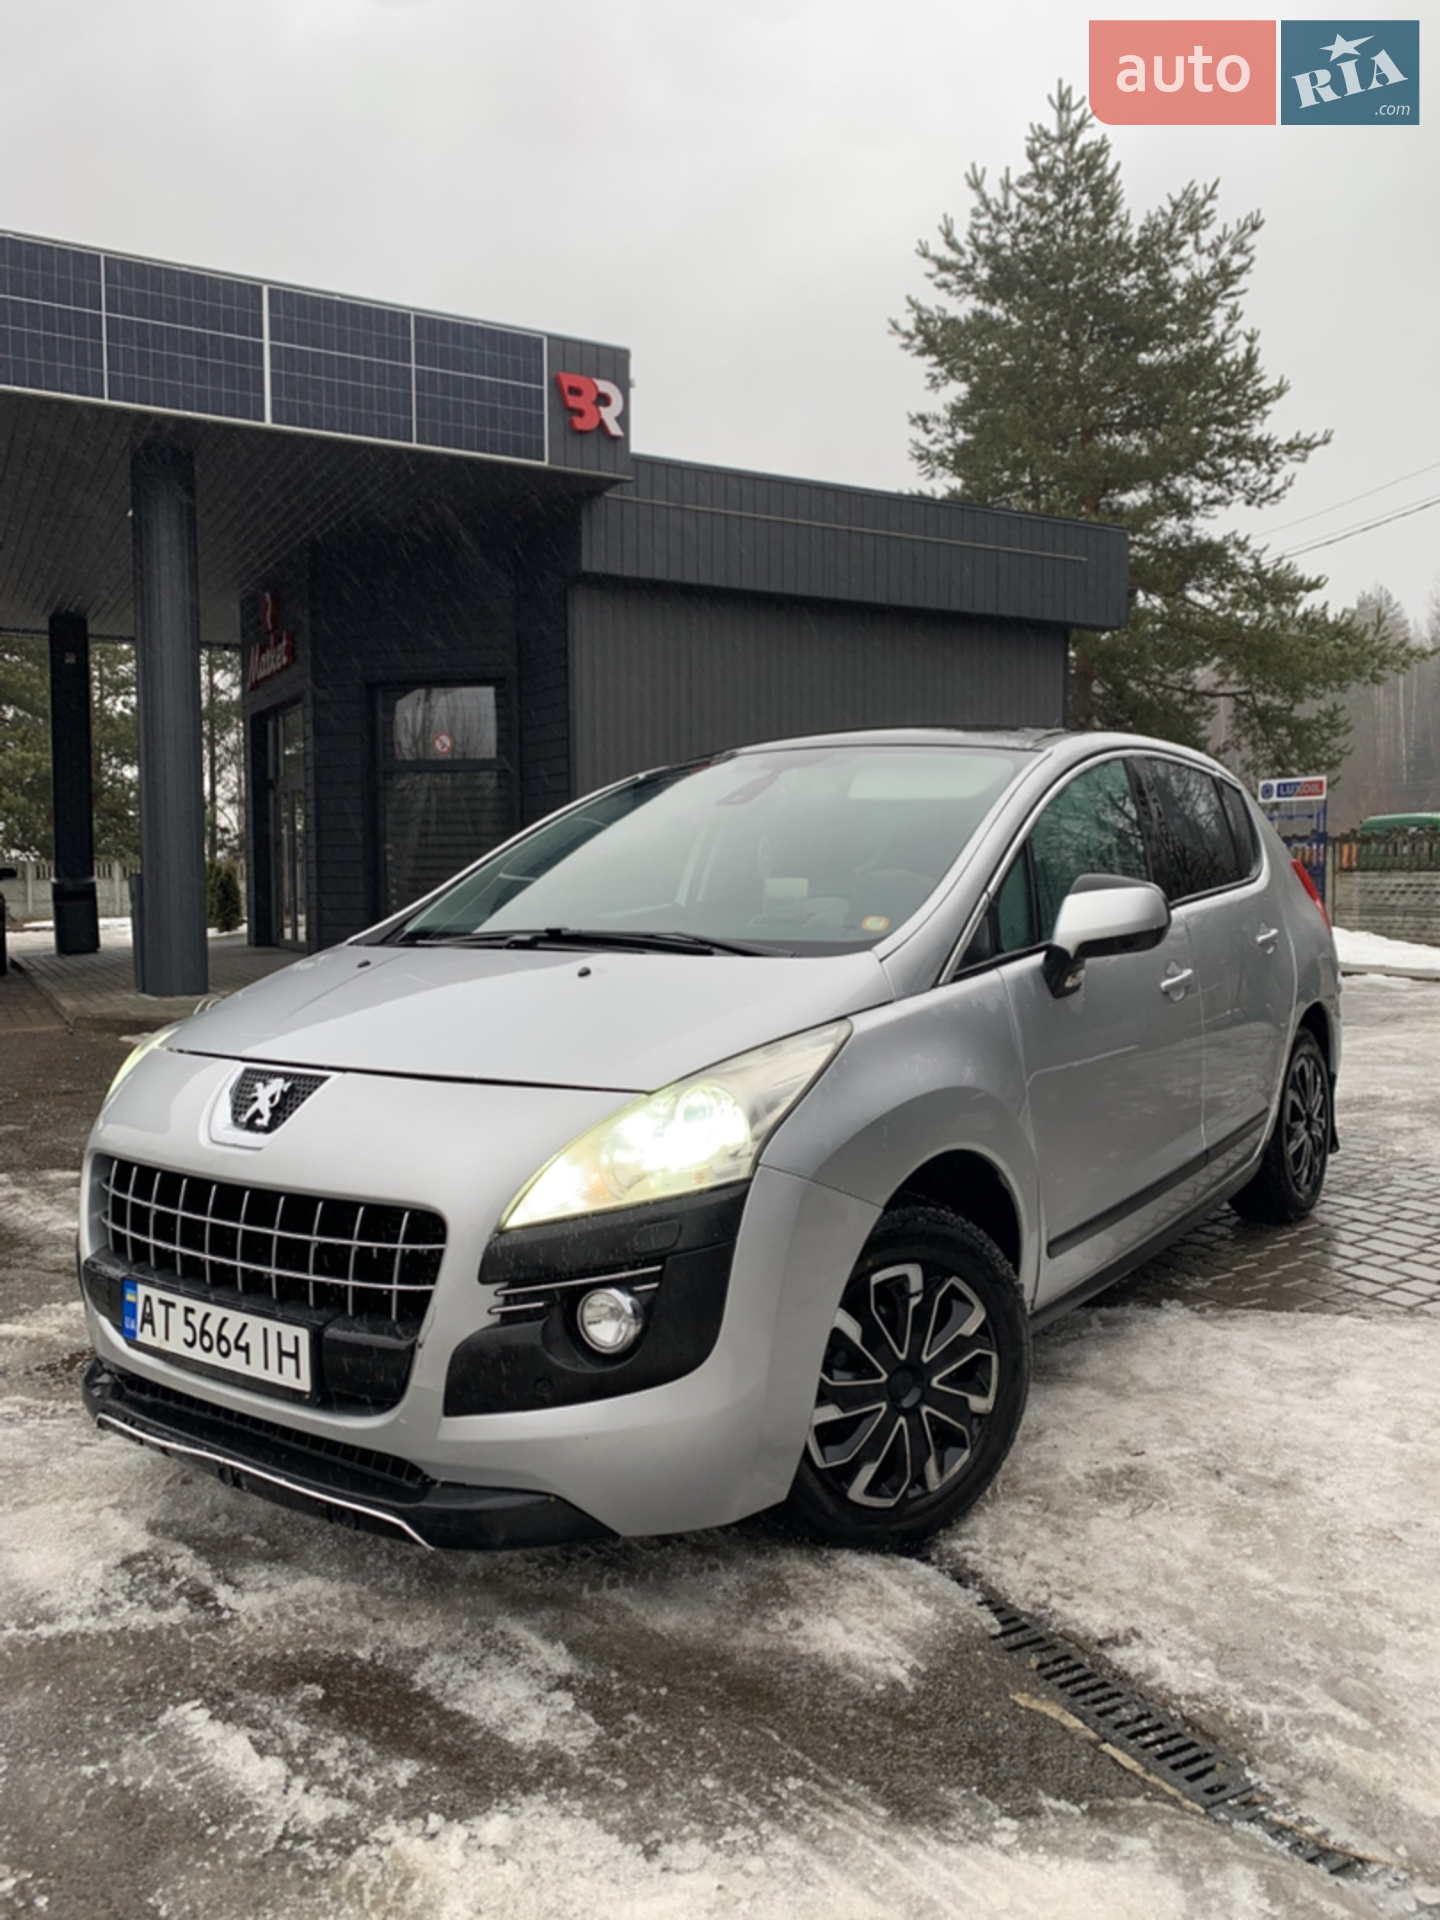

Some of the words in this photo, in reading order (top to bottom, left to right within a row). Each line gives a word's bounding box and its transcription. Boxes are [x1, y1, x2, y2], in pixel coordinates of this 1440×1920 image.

[139, 1294, 176, 1341] AT
[183, 1306, 250, 1365] 5664
[262, 1327, 300, 1379] IH
